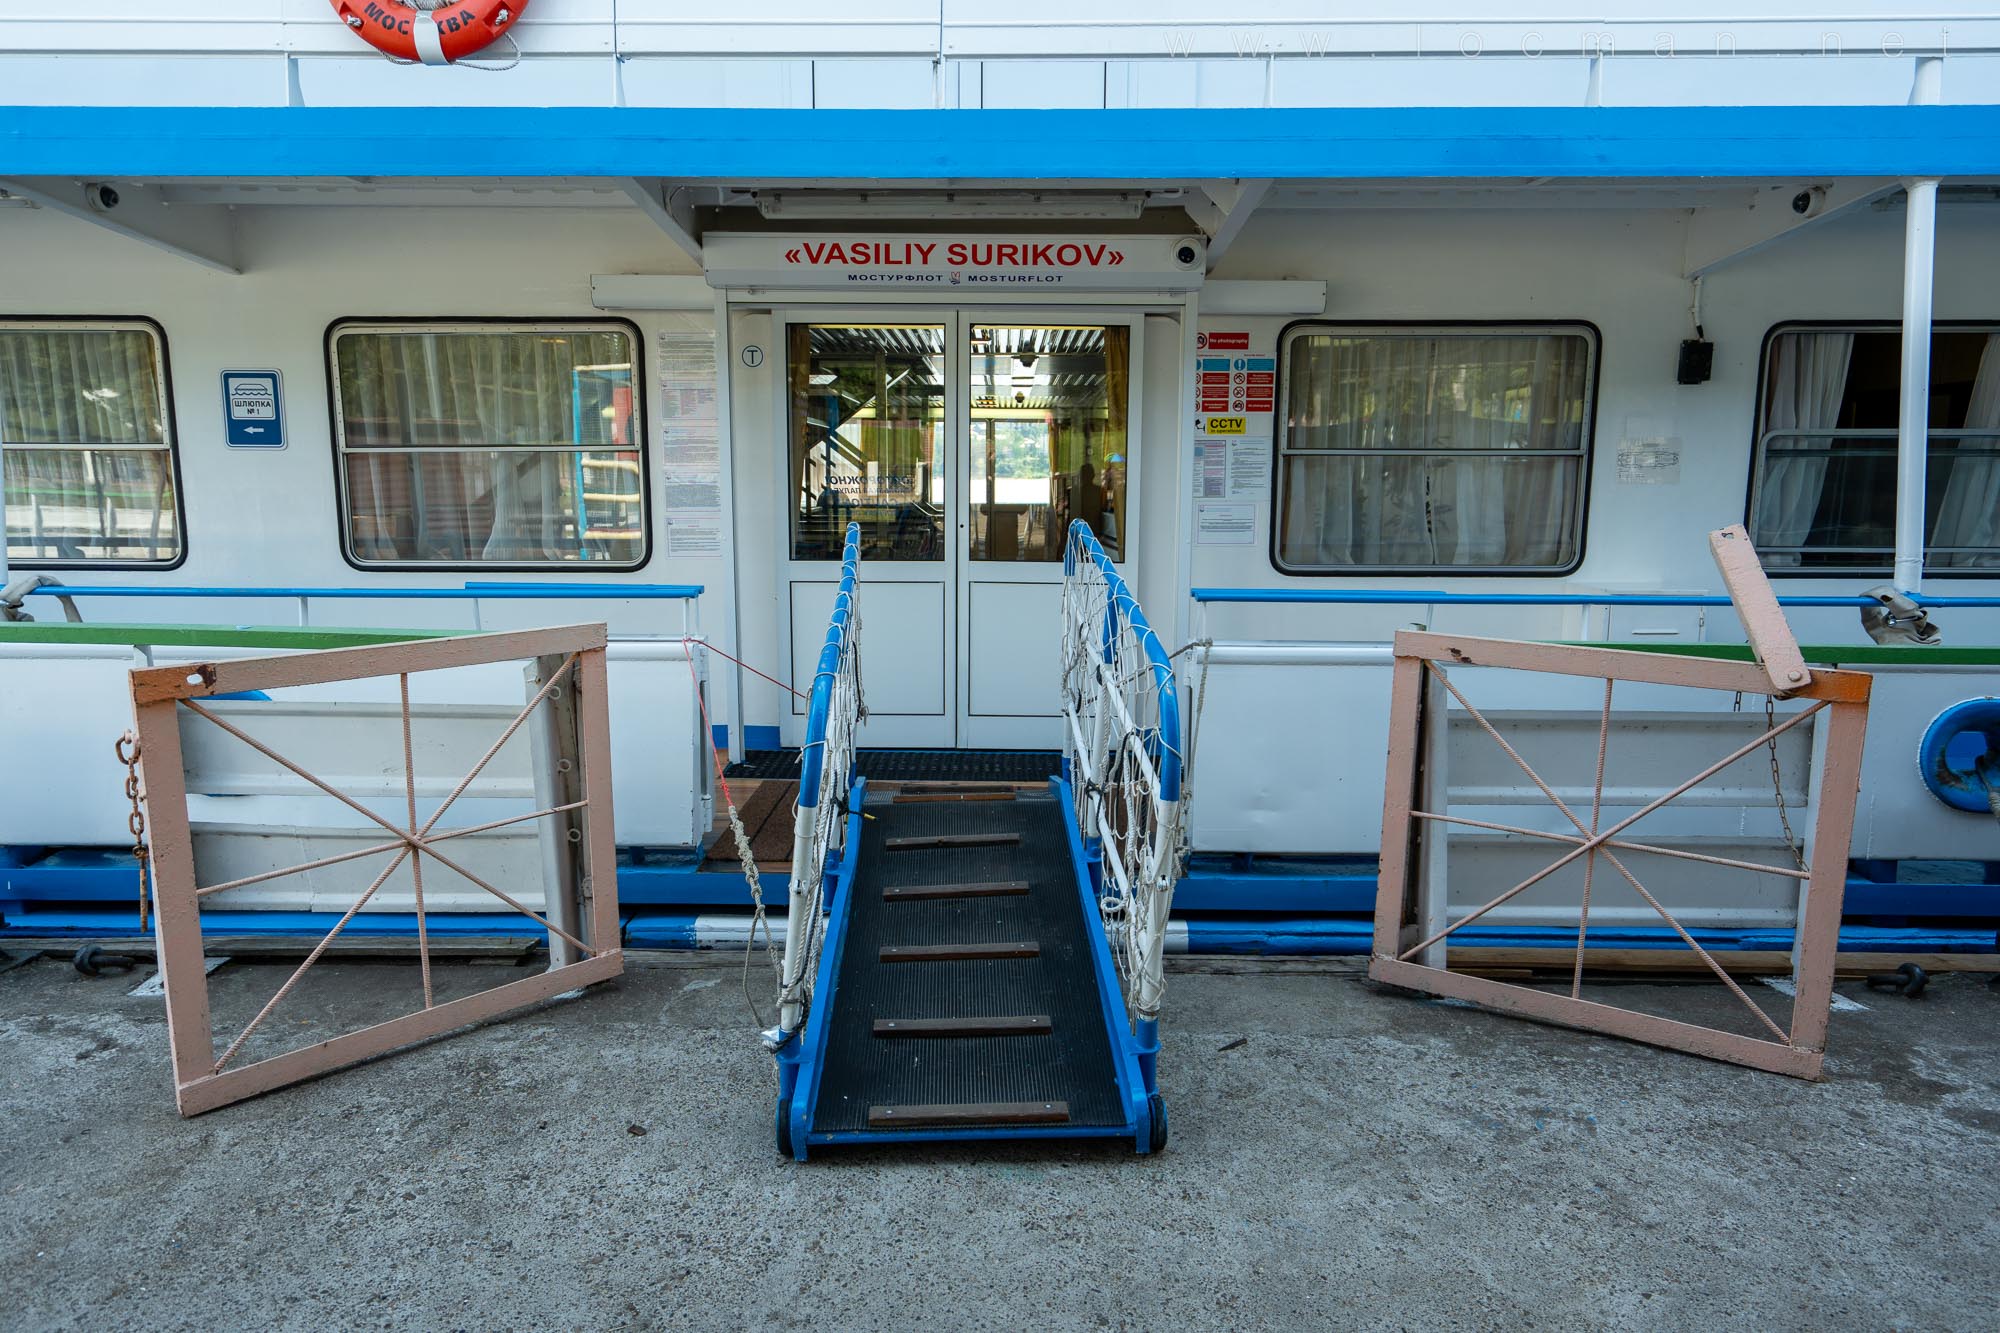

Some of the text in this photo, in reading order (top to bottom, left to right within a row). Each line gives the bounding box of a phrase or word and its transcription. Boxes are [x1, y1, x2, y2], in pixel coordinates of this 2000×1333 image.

[363, 1, 476, 35] МОСКВА
[785, 242, 1125, 266] «VASILIY SURIKOV»
[848, 273, 943, 282] МОСТУРФЛОТ
[968, 274, 1064, 283] MOSTURFLOT
[1210, 418, 1243, 428] CCTV
